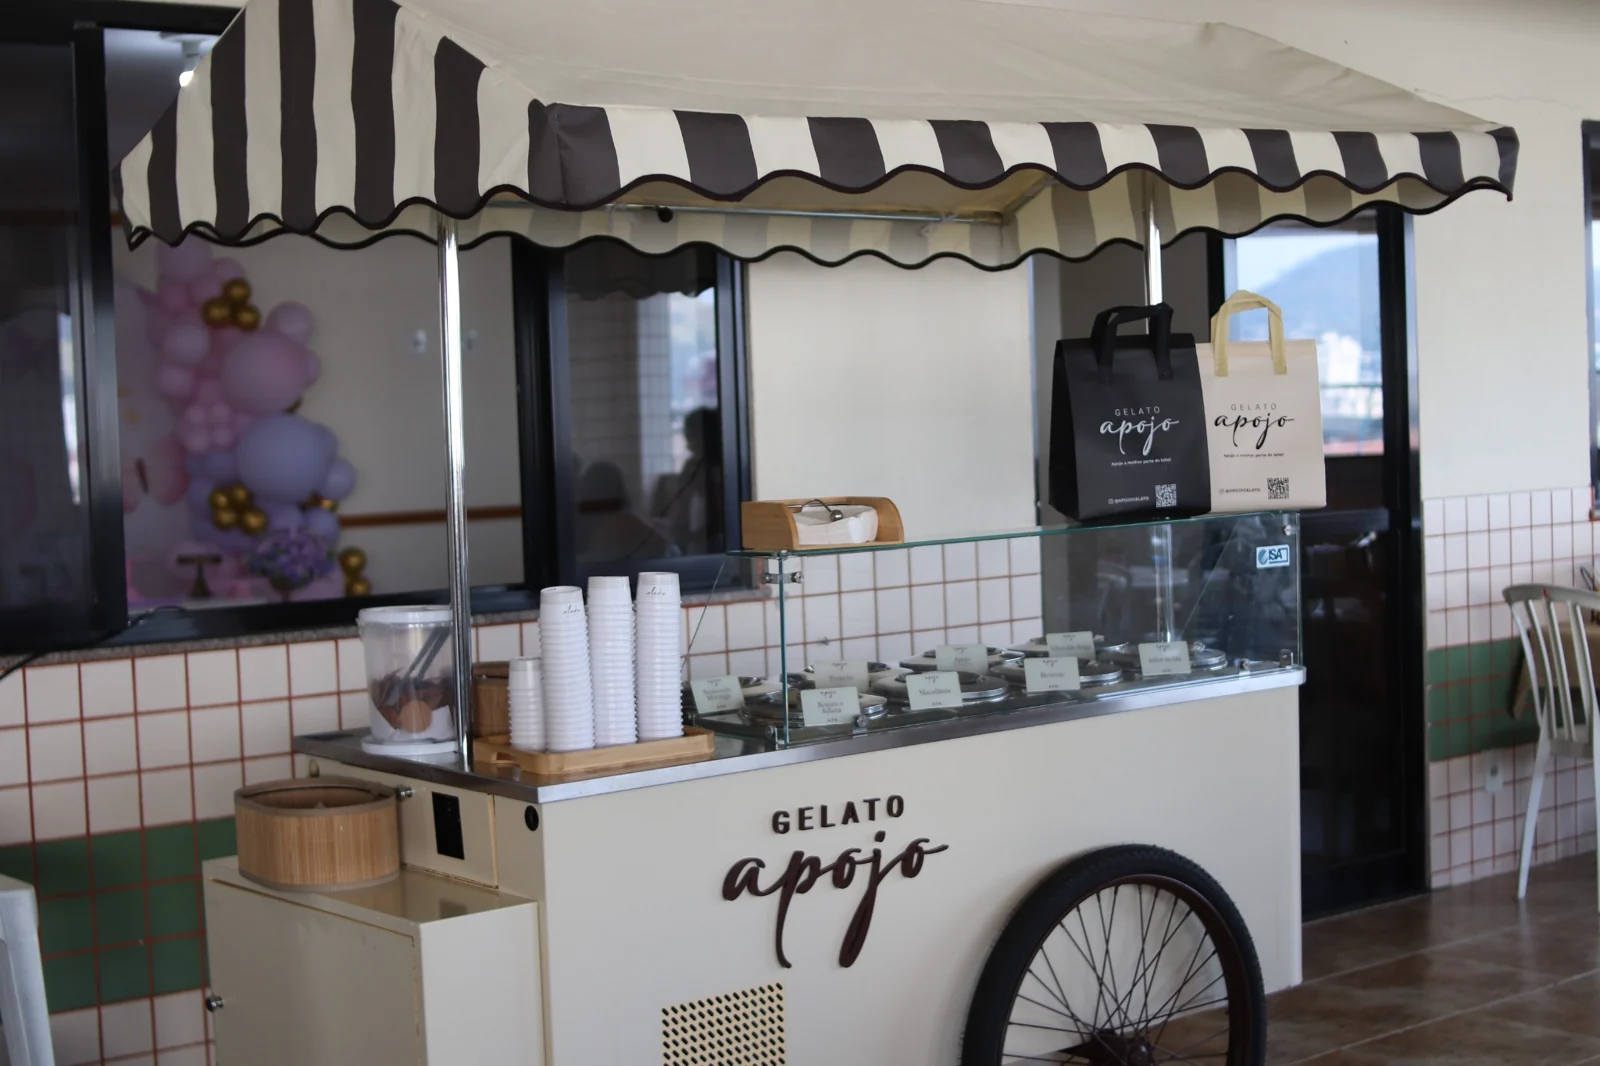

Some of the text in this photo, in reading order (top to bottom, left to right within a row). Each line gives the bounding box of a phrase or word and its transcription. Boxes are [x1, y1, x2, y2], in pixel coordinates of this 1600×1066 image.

[1114, 406, 1160, 416] GELATO
[1230, 403, 1276, 411] GELATO
[1100, 416, 1180, 456] apojo
[1214, 412, 1295, 450] apojo
[1269, 548, 1284, 561] ISA
[772, 794, 904, 834] GELATO
[722, 830, 950, 968] apojo
